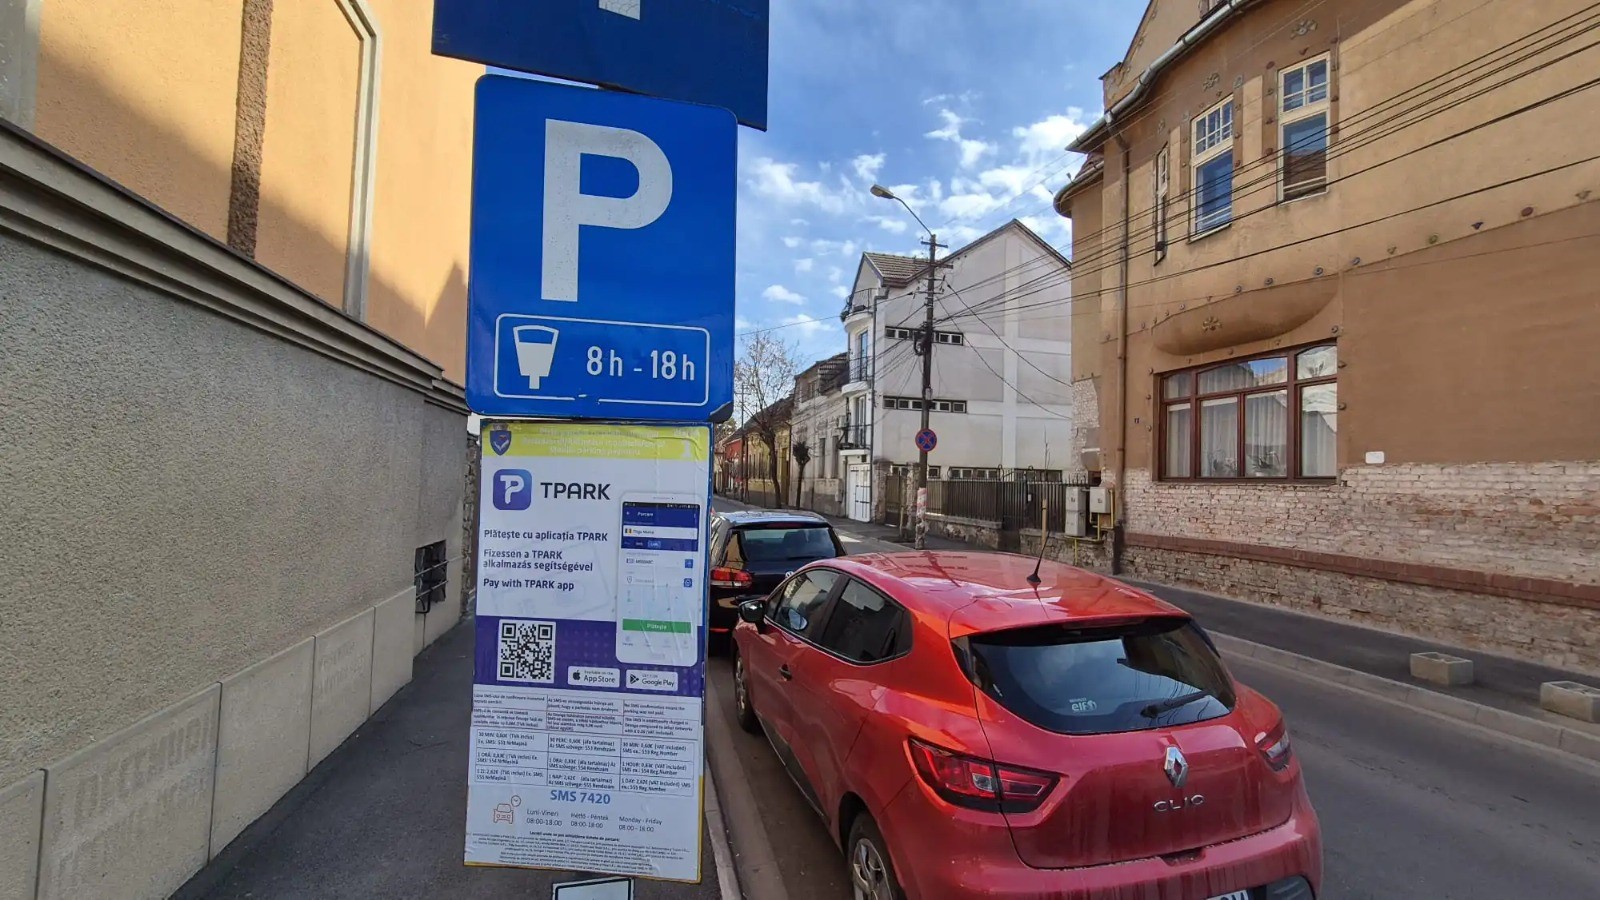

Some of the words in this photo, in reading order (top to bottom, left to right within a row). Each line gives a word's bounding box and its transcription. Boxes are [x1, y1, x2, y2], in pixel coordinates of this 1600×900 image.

[541, 118, 673, 302] P
[540, 482, 610, 500] TPARK
[484, 529, 520, 540] Plătește
[535, 531, 575, 542] aplicația
[577, 532, 608, 541] TPARK
[484, 549, 522, 558] Fizessen
[532, 550, 563, 560] TPARK
[483, 560, 532, 569] alkalmazás
[534, 561, 593, 572] segítségével
[484, 578, 499, 589] Pay
[502, 579, 522, 588] with
[525, 580, 555, 589] TPARK
[558, 582, 575, 592] app
[584, 674, 599, 683] App
[642, 678, 662, 686] Google
[550, 790, 577, 802] SMS
[580, 793, 611, 804] 7420
[1153, 794, 1204, 812] CLIO
[619, 816, 641, 824] Monday
[646, 818, 662, 826] Friday
